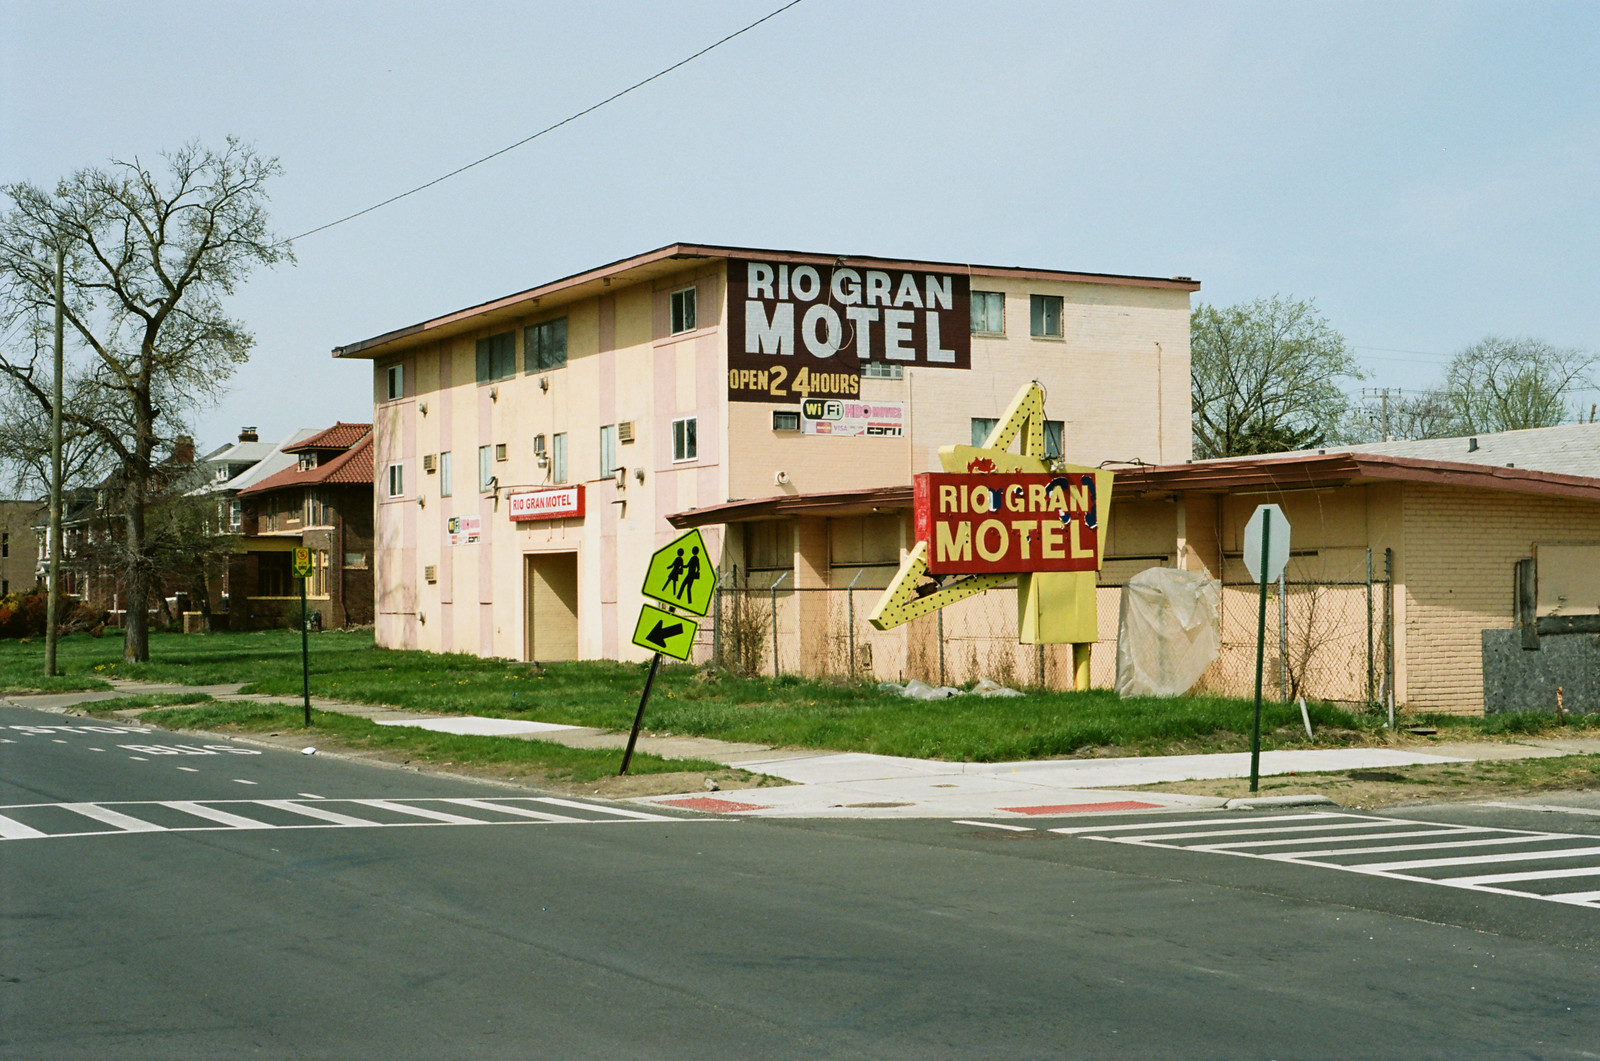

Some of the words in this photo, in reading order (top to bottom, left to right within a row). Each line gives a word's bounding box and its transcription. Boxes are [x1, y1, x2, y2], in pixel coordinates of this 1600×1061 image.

[748, 262, 821, 301] RIO
[831, 268, 953, 310] GRAN
[745, 300, 955, 363] MOTEL
[729, 368, 769, 391] OPEN
[810, 372, 859, 394] HOURS
[513, 499, 524, 510] RIO
[526, 497, 545, 509] GRAN
[546, 494, 571, 507] MOTEL
[938, 485, 989, 514] RIO
[1005, 484, 1089, 513] GRAN
[936, 519, 1094, 562] MOTEL
[116, 744, 262, 755] BUS
